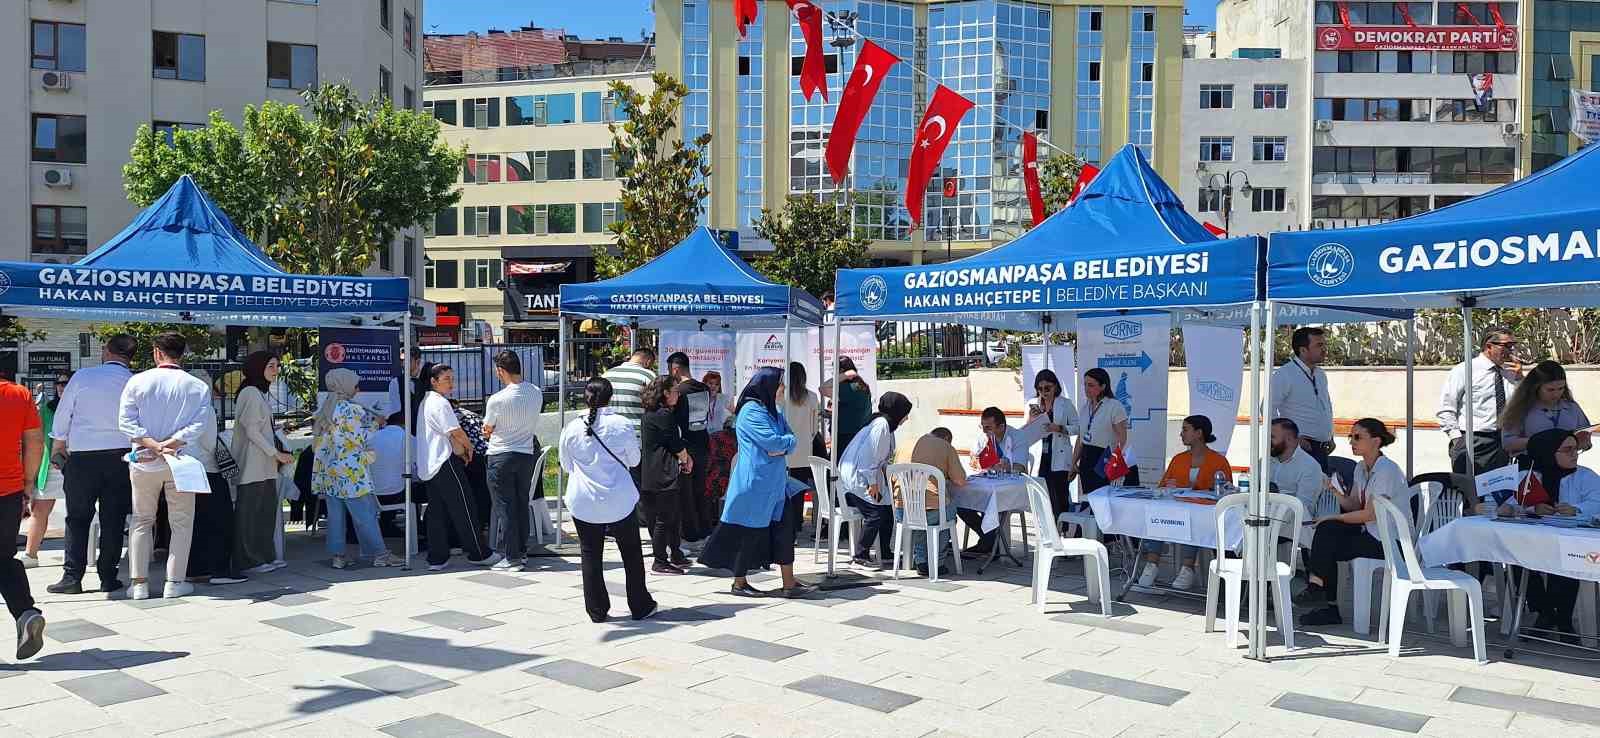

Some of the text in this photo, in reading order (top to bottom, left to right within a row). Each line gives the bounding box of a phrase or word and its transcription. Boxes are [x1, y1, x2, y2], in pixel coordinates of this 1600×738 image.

[1355, 29, 1497, 43] DEMOKRAT PARTİ
[39, 287, 106, 302] HAKAN
[112, 291, 218, 305] BAHÇETEPE
[904, 294, 951, 308] HAKAN
[955, 289, 1041, 307] BAHÇETEPE
[1056, 284, 1129, 302] BELEDİYE
[1133, 281, 1208, 299] BAŞKANI
[610, 303, 639, 311] HAKAN
